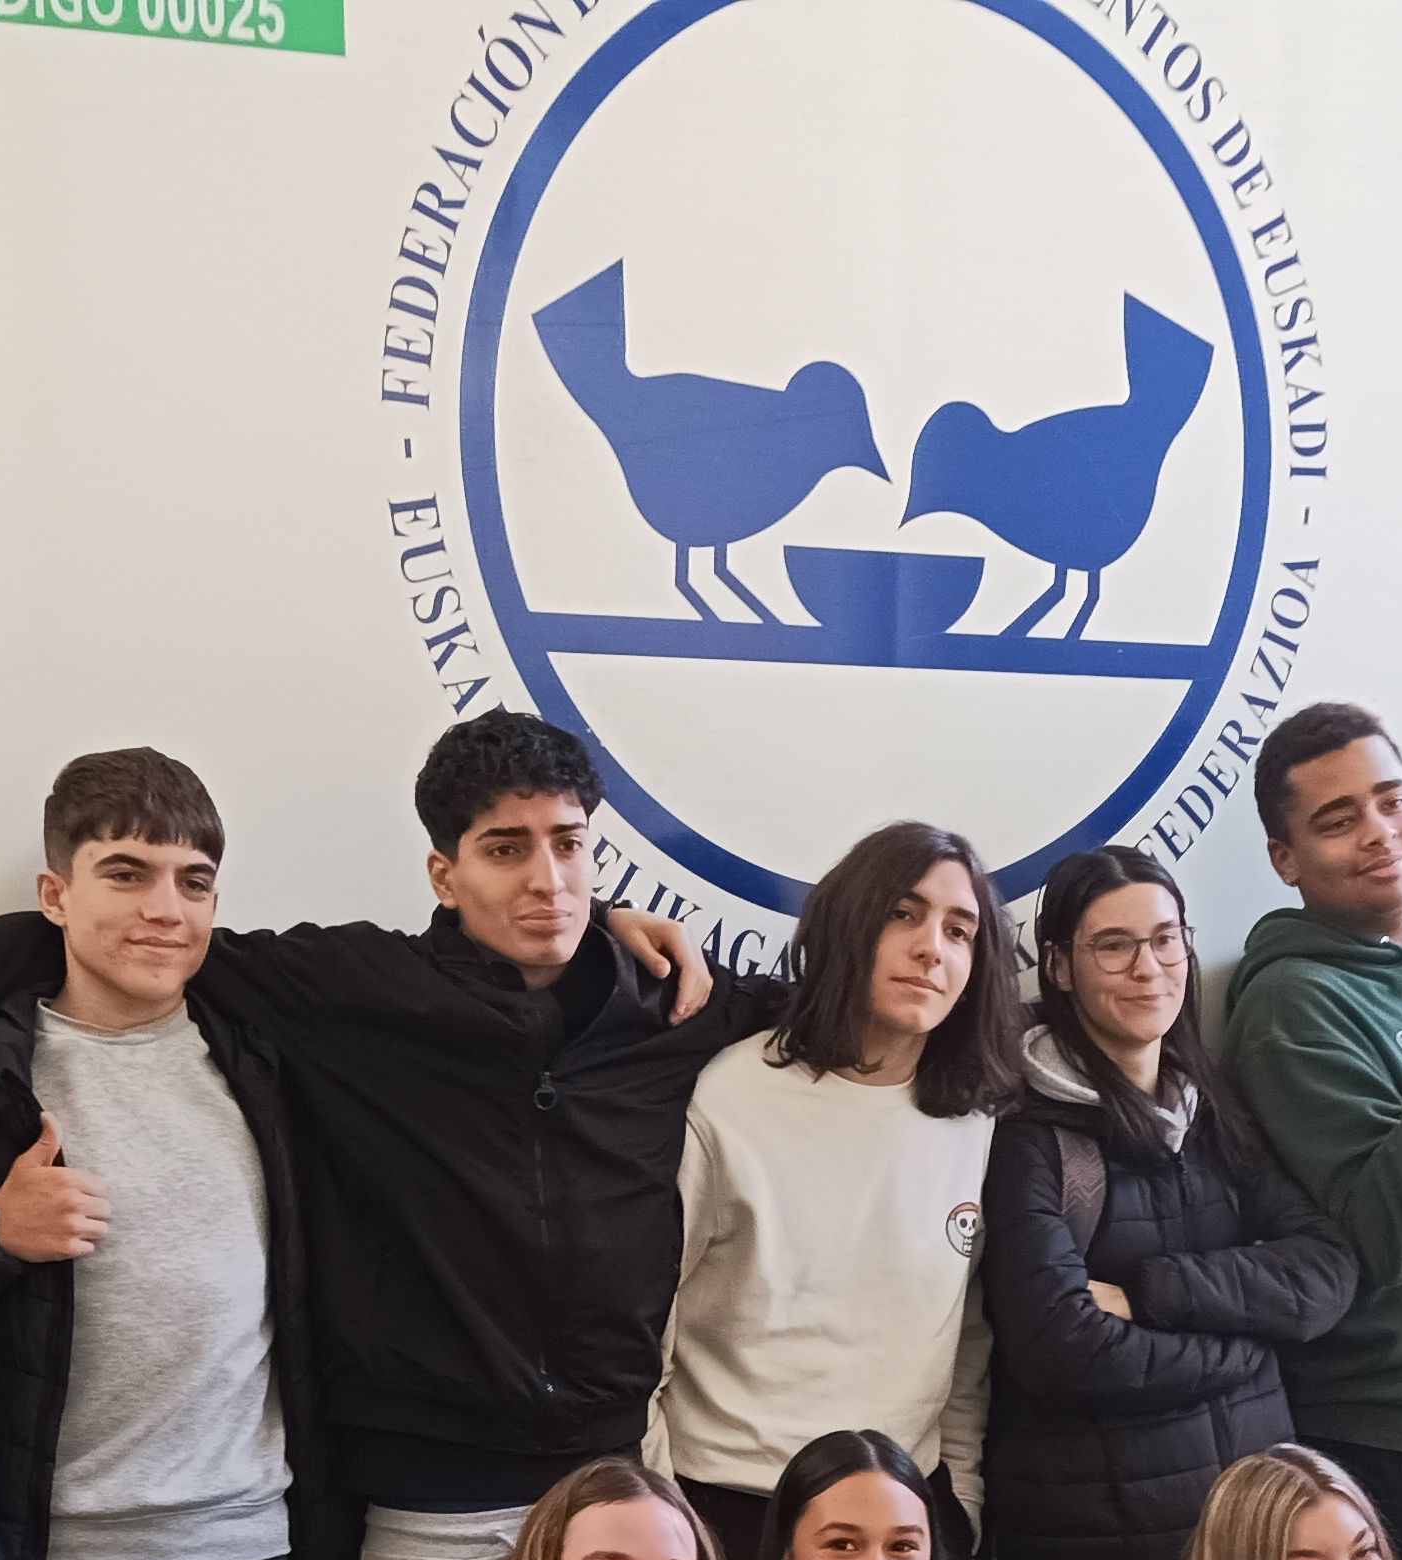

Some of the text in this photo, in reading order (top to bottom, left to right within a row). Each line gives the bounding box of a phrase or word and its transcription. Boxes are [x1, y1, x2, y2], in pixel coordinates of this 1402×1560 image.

[381, 0, 566, 411] FEDERACIÓN
[1208, 114, 1274, 210] DE
[1248, 207, 1329, 480] EUSKADI
[386, 491, 494, 716] EUSKA
